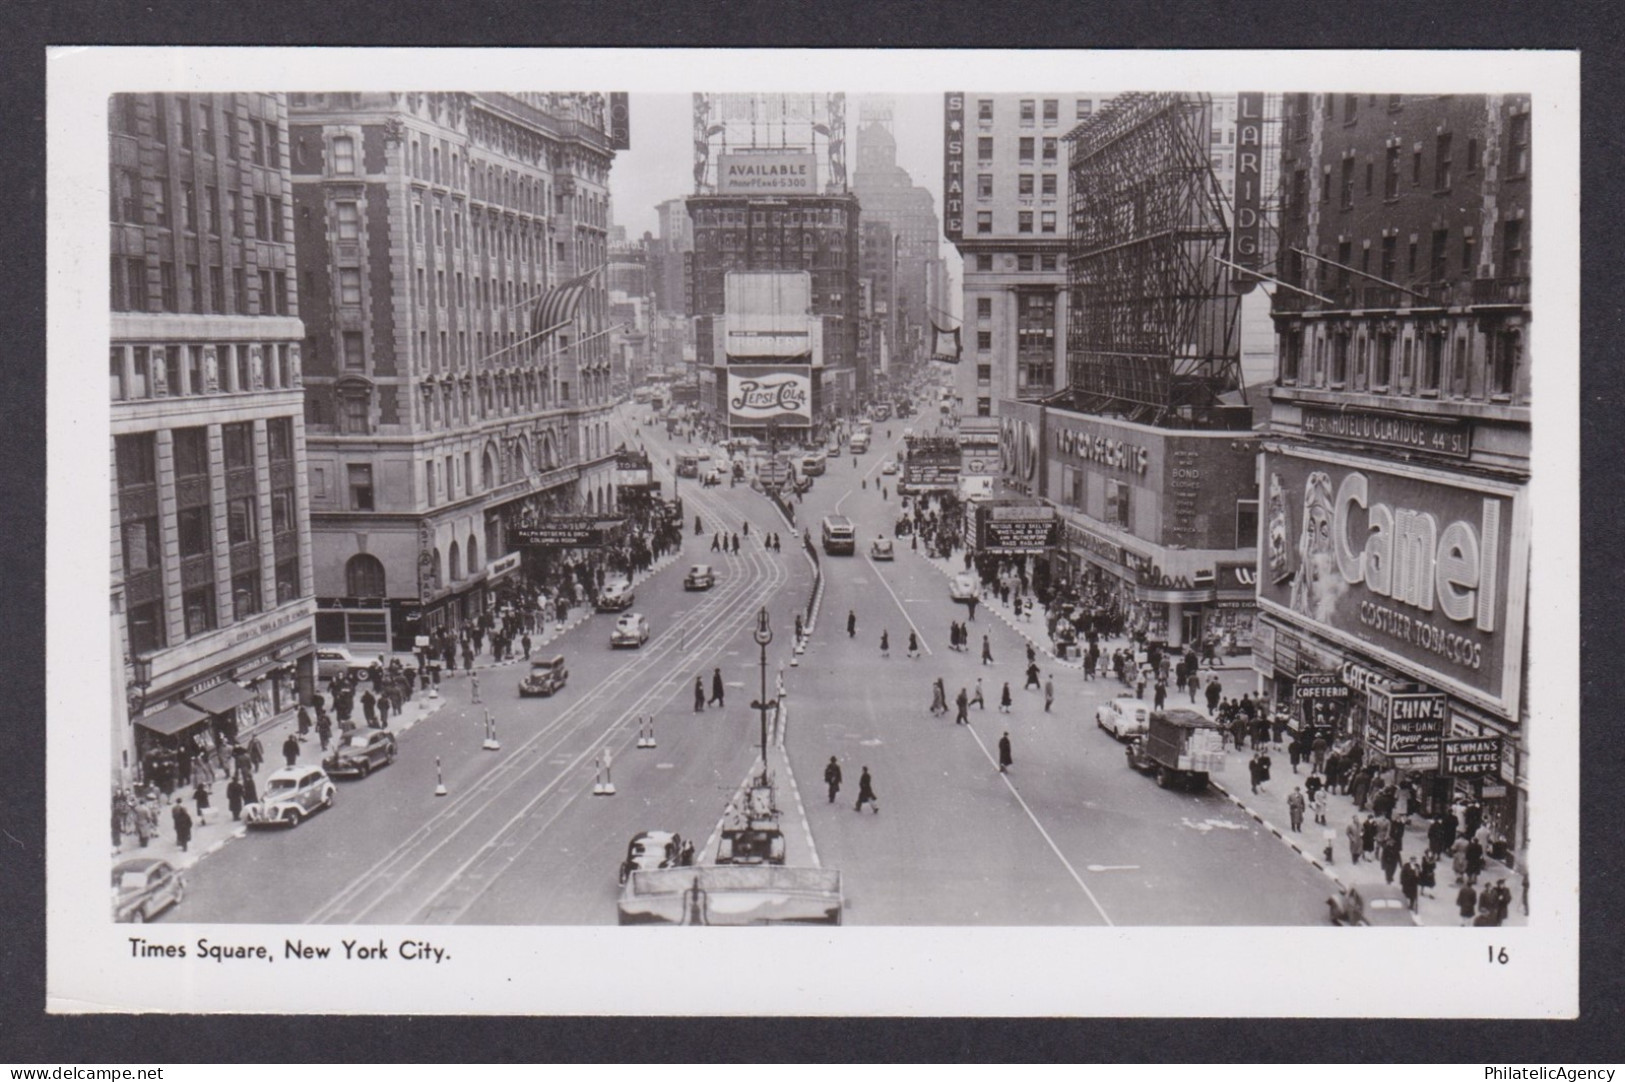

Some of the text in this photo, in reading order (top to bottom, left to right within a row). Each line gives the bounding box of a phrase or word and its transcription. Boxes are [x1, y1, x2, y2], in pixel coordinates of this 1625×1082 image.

[728, 164, 807, 176] AVAILABLE
[948, 141, 962, 232] STATE
[1332, 414, 1361, 437] HOTEL
[1372, 419, 1426, 446] CLARIDGE
[1172, 468, 1200, 479] BOND
[1333, 471, 1501, 634] Camel
[1414, 619, 1482, 669] TOBACCOS
[1301, 675, 1337, 685] HECTOR'S
[1296, 686, 1349, 698] CAFETERIA
[1393, 697, 1444, 720] CHIN'S
[1446, 741, 1499, 754] NEWMAN'S
